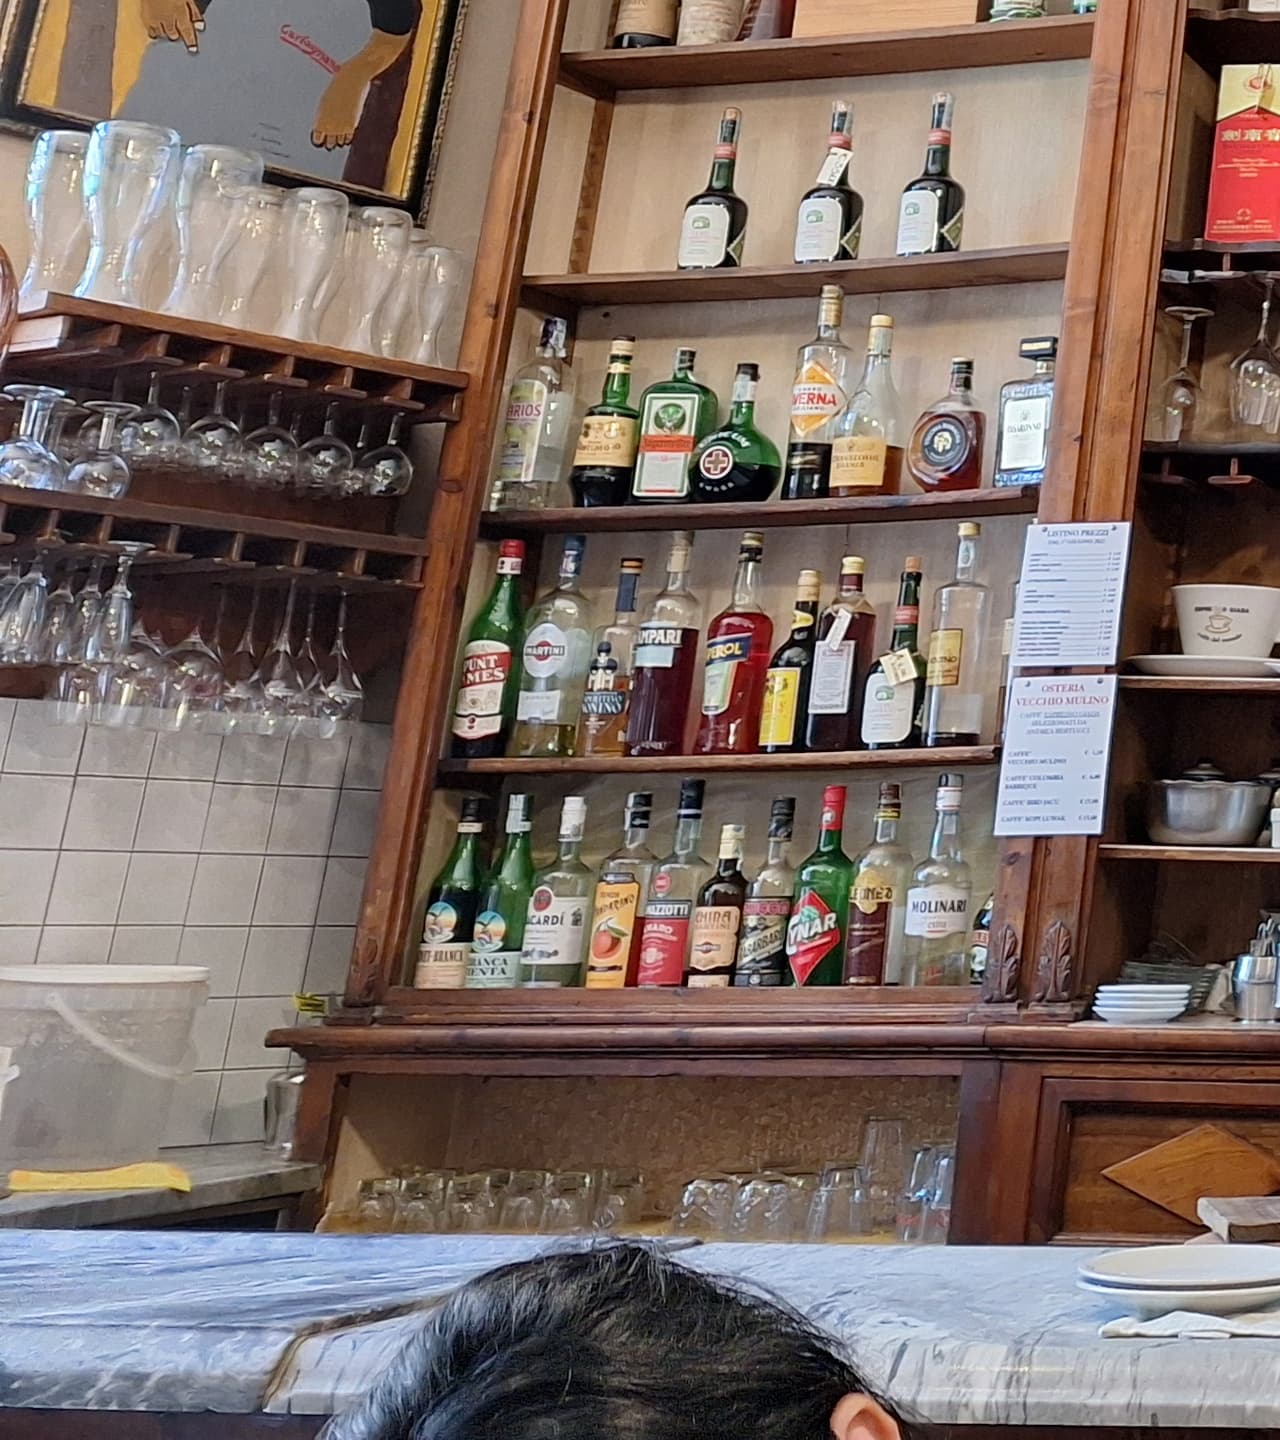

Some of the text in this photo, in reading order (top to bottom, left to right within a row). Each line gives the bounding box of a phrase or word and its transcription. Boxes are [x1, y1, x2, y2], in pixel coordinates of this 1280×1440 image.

[792, 392, 838, 406] VERNA
[506, 404, 542, 418] ARIOS
[637, 629, 683, 645] AMPARI
[524, 645, 566, 657] MARTINI
[705, 641, 743, 660] PEROL
[463, 655, 498, 669] PUNT
[466, 667, 506, 682] MES
[1041, 683, 1085, 693] OSTERIA
[1016, 695, 1110, 707] VECCHIO MULINO
[911, 898, 967, 913] MOLINARI
[526, 911, 564, 927] CARDÍ
